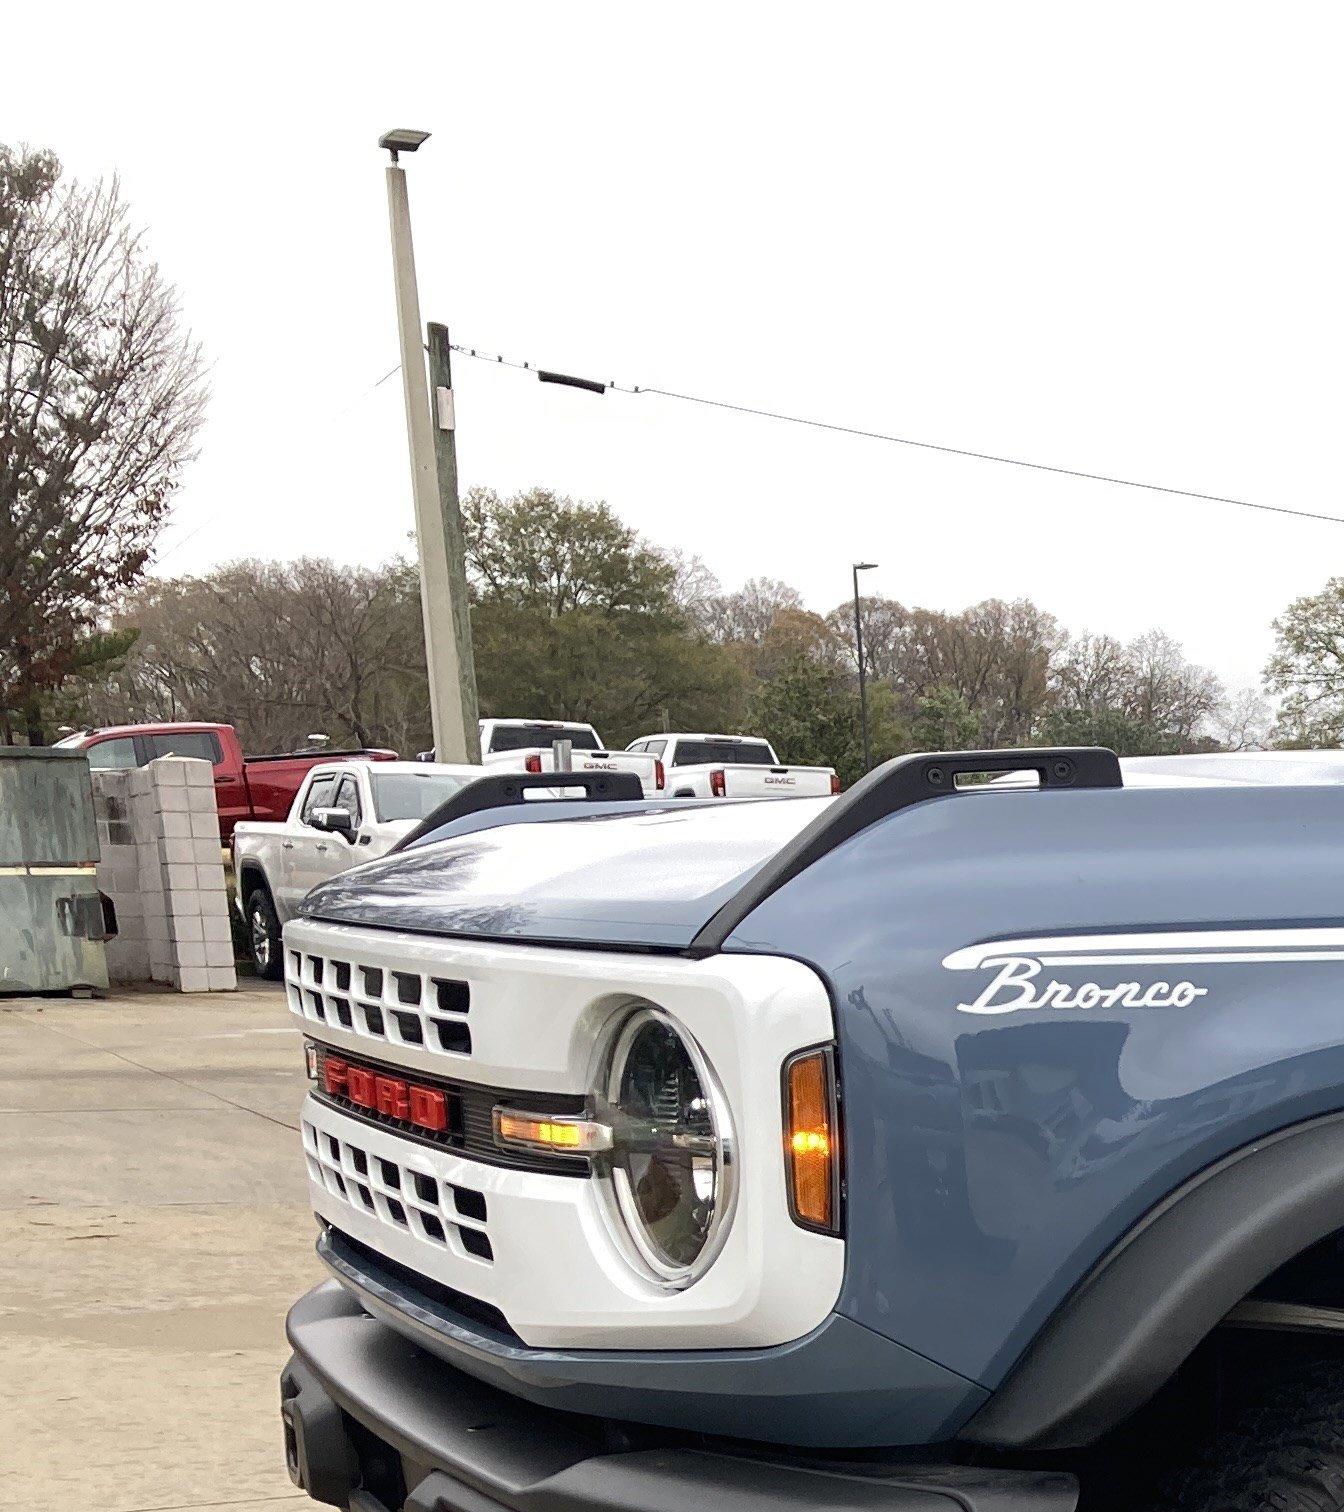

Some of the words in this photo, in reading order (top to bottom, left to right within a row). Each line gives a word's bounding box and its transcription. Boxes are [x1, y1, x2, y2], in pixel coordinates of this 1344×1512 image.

[583, 762, 617, 770] GMC
[764, 777, 796, 785] GMC
[956, 956, 1209, 1015] Bronco
[324, 1057, 449, 1131] FORD
